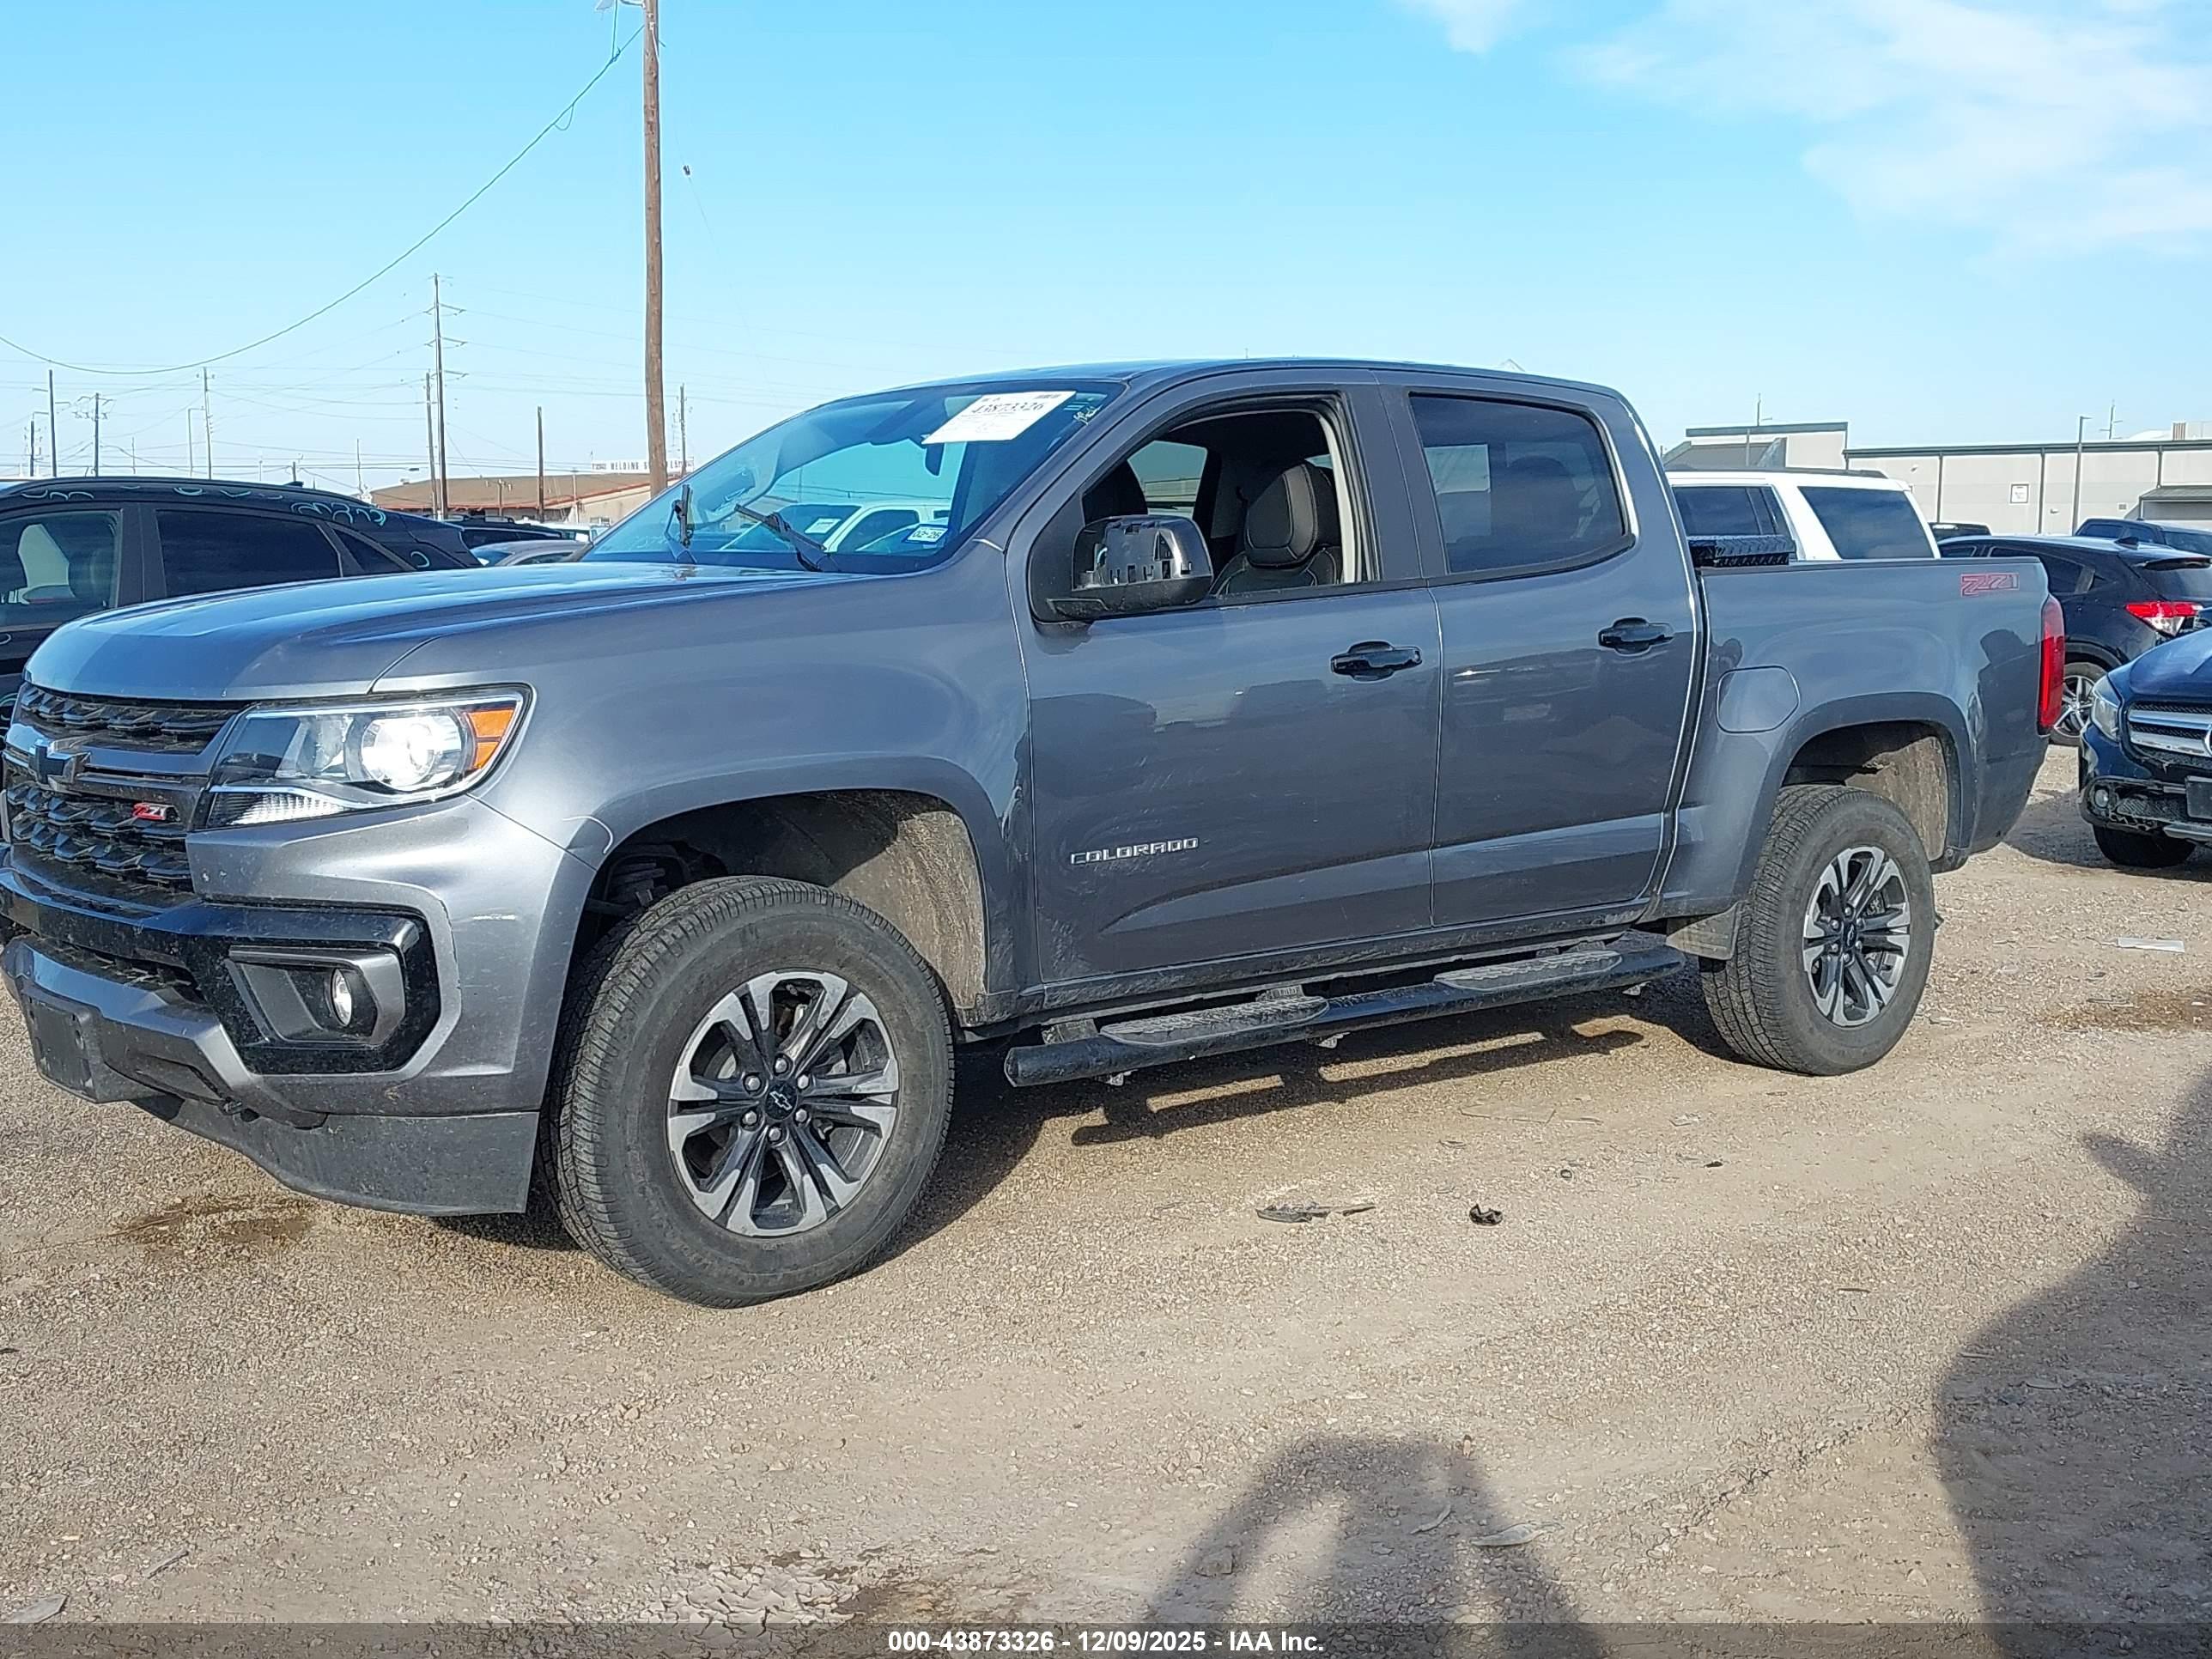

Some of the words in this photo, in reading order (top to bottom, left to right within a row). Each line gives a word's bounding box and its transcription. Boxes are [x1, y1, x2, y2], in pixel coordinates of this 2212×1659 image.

[1960, 573, 2019, 597] Z71
[132, 802, 167, 821] Z71
[1071, 837, 1199, 865] COLORADO
